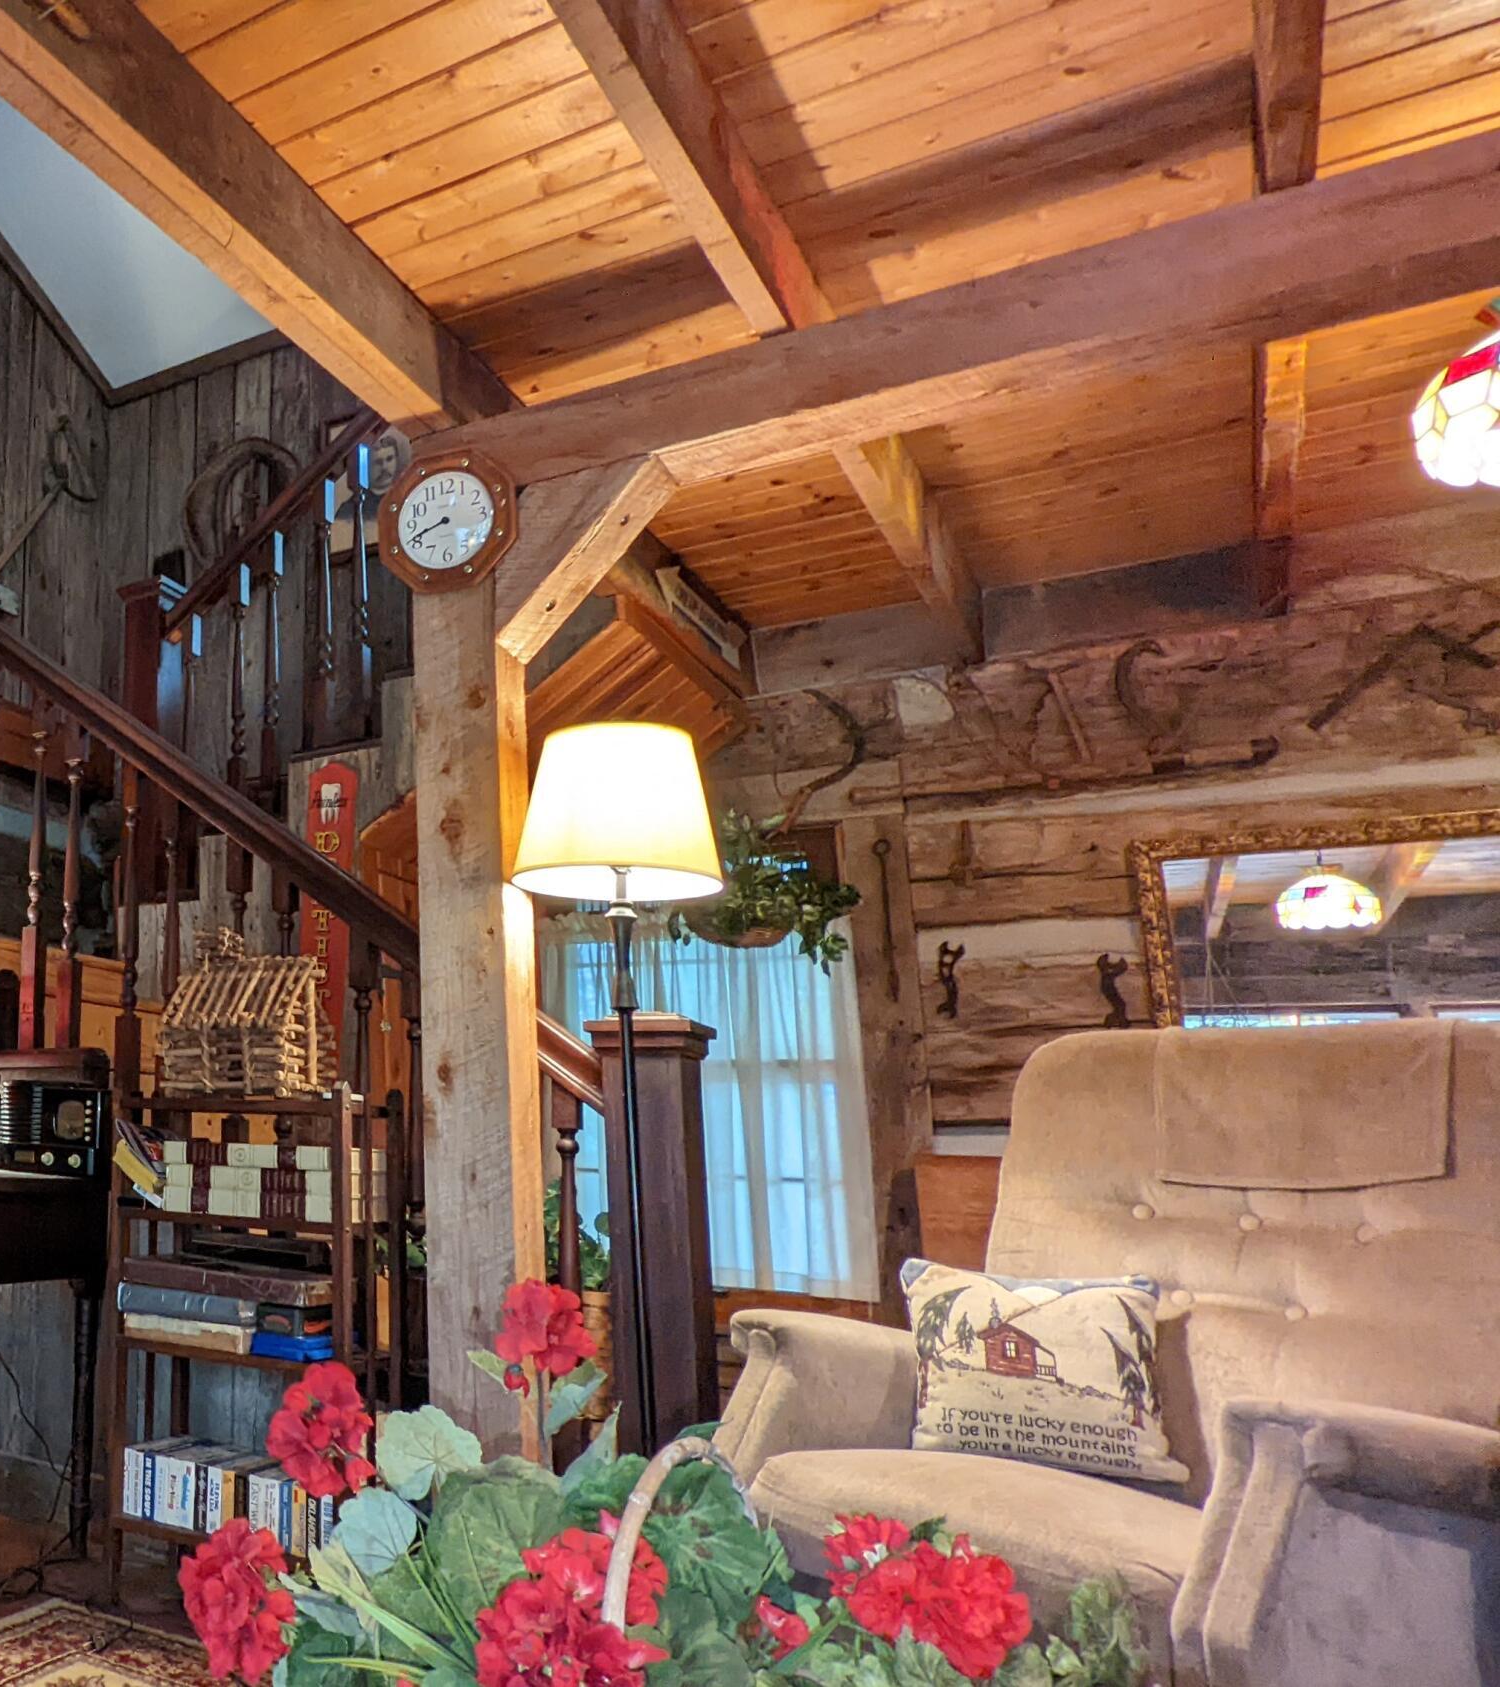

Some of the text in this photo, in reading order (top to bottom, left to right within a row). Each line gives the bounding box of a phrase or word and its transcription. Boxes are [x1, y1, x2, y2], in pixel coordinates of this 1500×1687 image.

[425, 486, 436, 502] 11
[439, 478, 455, 495] 12
[460, 480, 465, 495] 1
[471, 489, 481, 506] 2
[412, 502, 427, 518] 10
[479, 506, 488, 522] 3
[406, 520, 417, 534] 9
[411, 533, 423, 549] 8
[425, 545, 437, 561] 7
[442, 546, 453, 562] 6
[941, 1407, 1138, 1441] If you're lucky enough
[936, 1422, 1136, 1457] to be in the mountains
[1017, 1444, 1062, 1458] lucky
[144, 1469, 152, 1486] THE
[143, 1487, 152, 1517] SOUP
